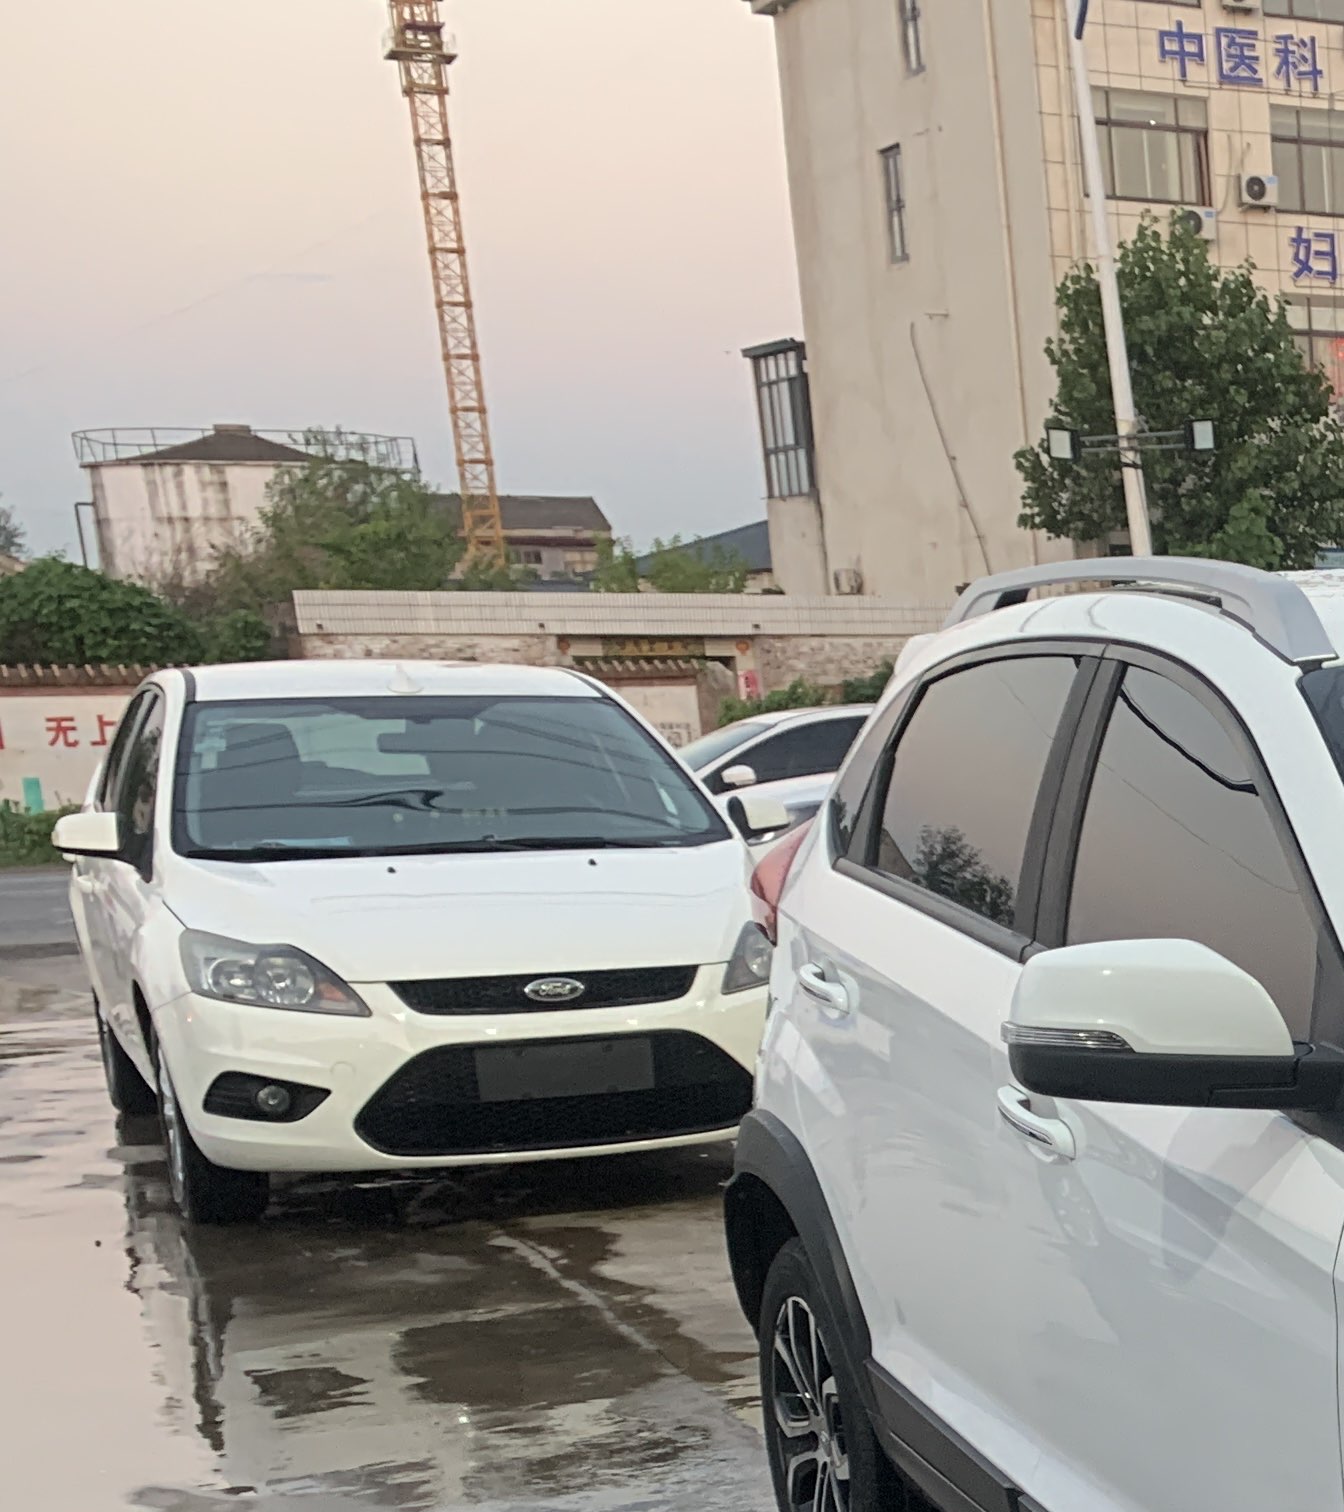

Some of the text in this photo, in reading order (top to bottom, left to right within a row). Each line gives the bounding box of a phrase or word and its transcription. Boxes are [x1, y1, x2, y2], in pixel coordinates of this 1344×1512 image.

[1158, 20, 1323, 93] 中医科
[539, 982, 571, 996] Ford
